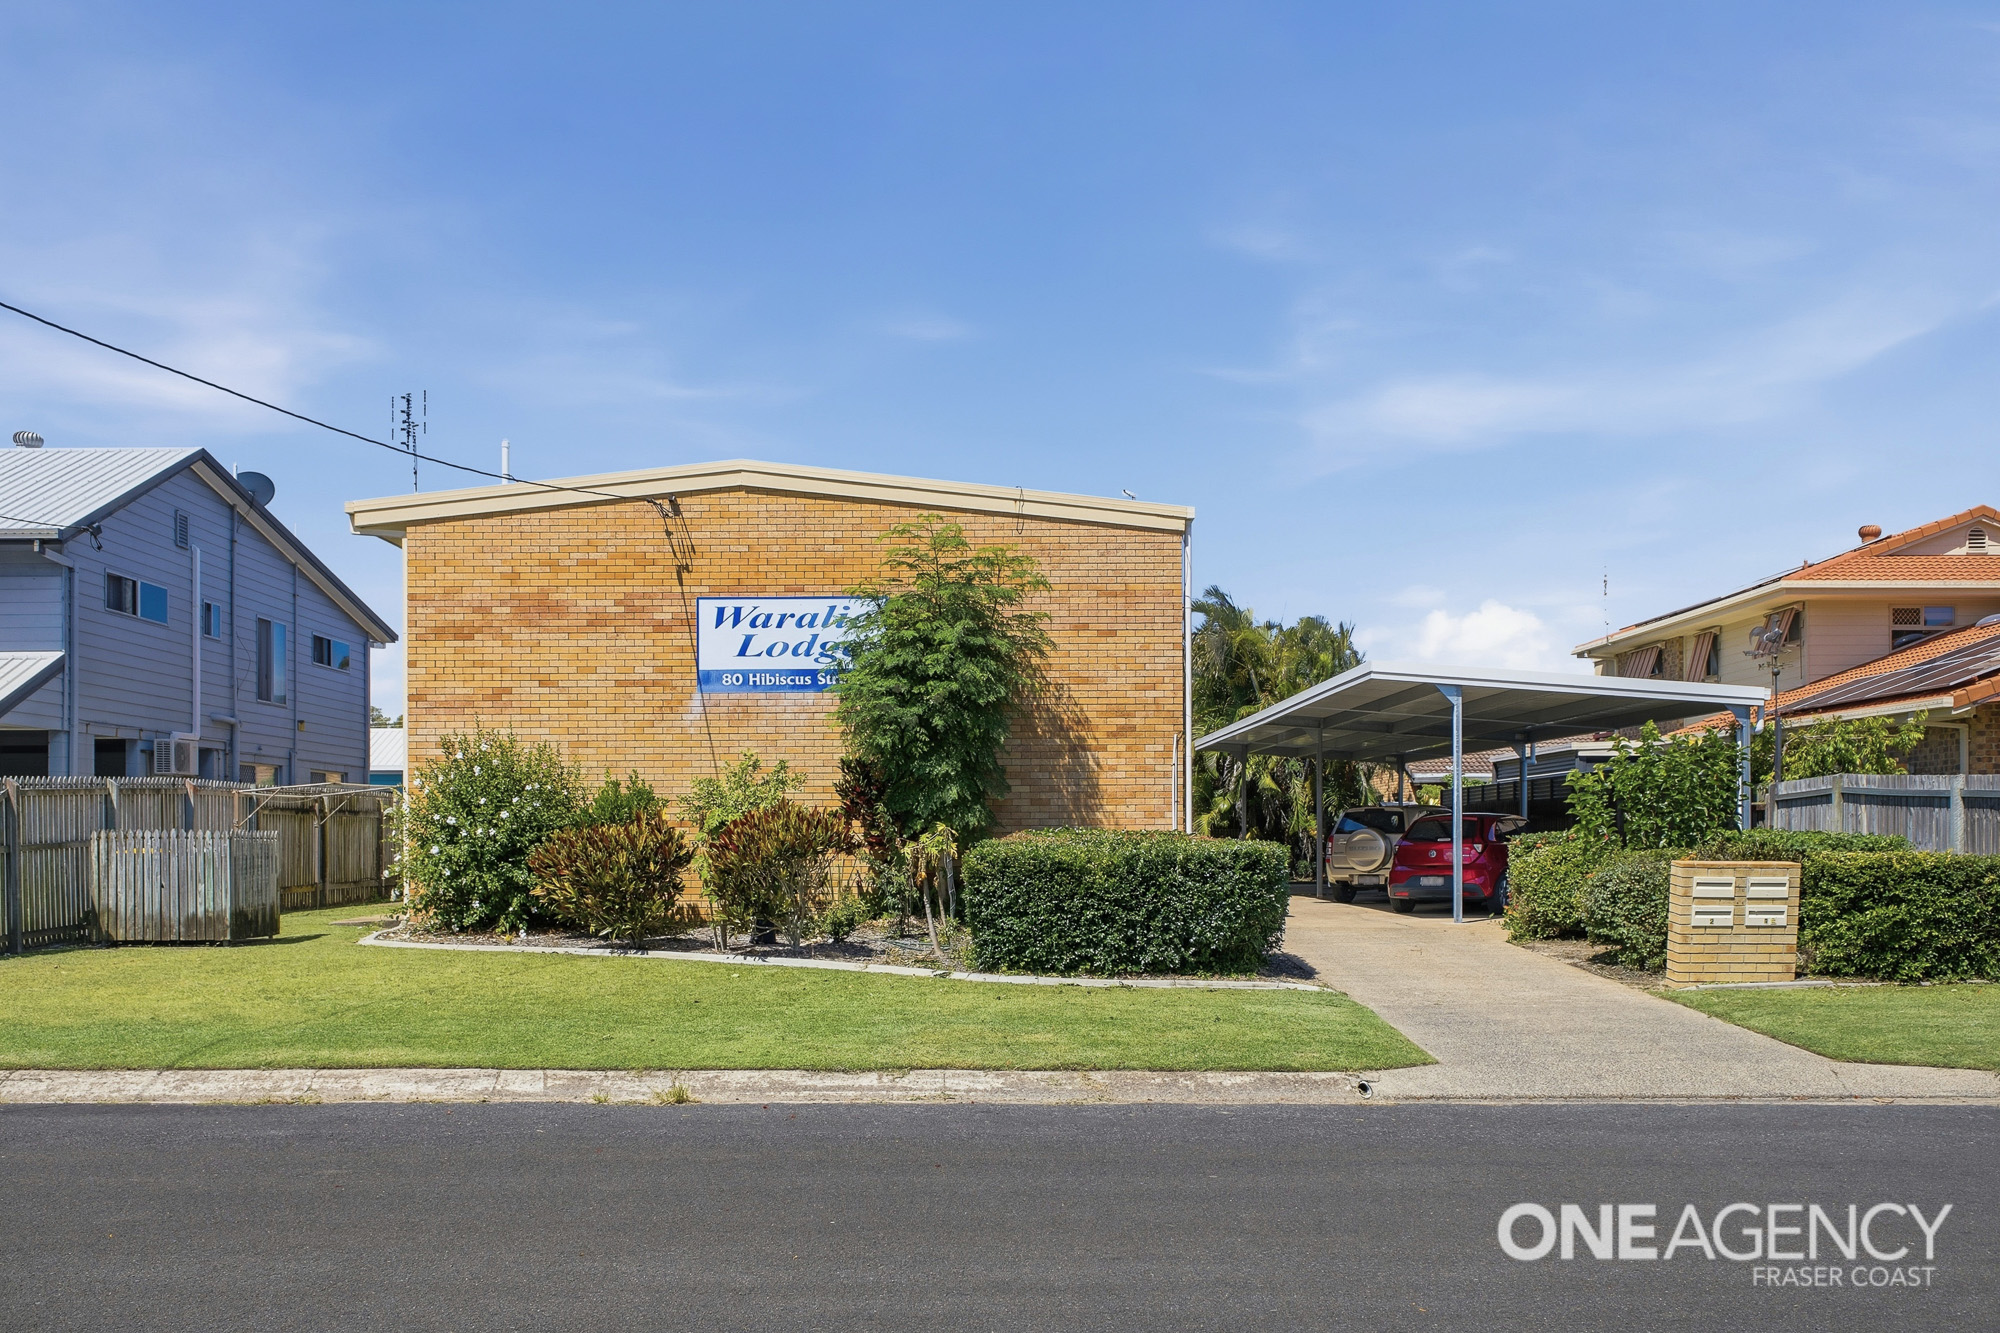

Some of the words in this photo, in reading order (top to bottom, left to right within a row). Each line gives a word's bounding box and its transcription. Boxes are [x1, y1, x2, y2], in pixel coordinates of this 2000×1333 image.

[714, 604, 852, 630] Warali
[721, 673, 743, 686] 80
[748, 672, 812, 686] Hibiscus
